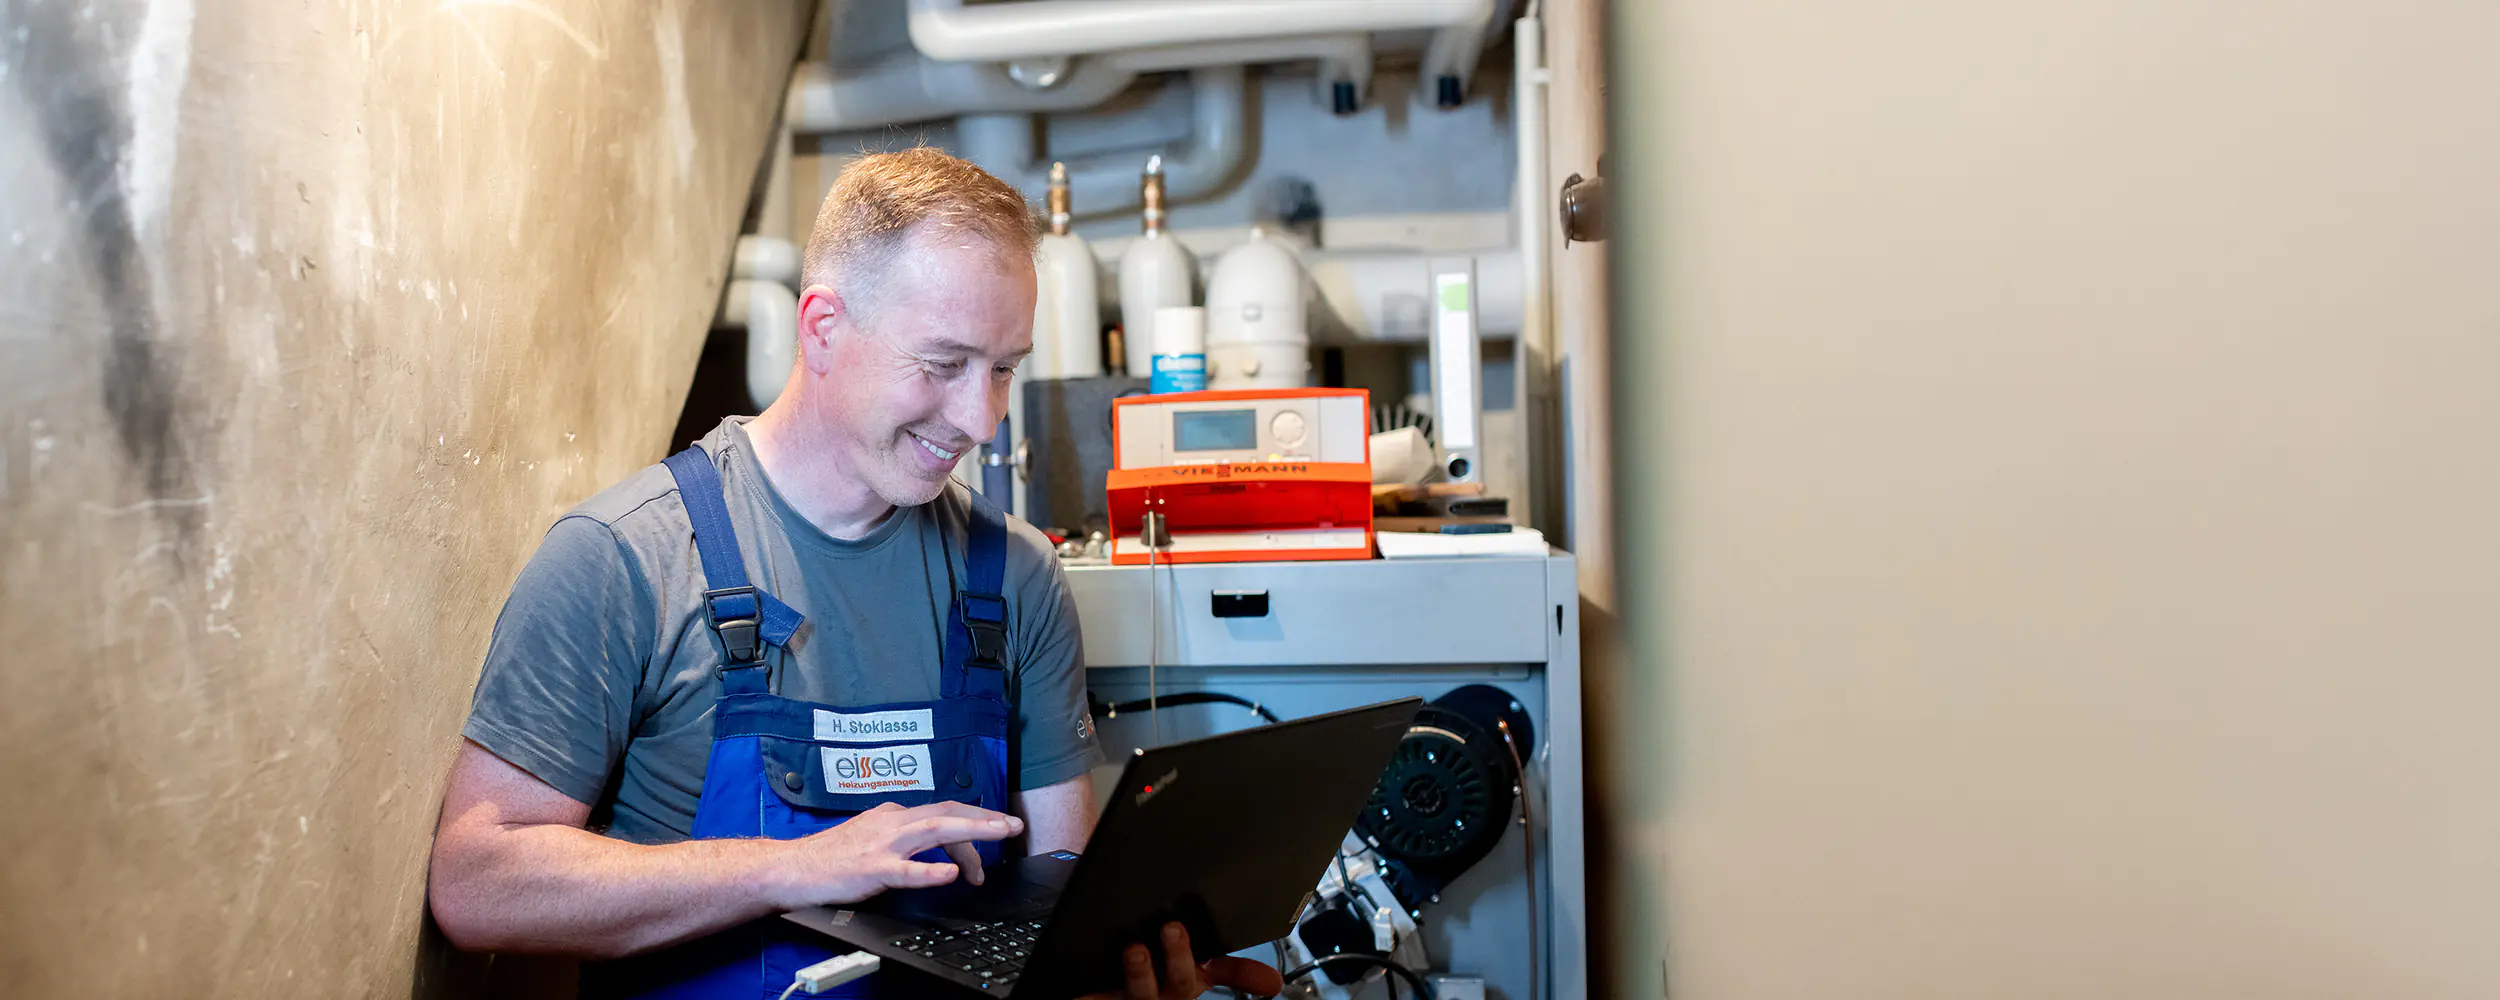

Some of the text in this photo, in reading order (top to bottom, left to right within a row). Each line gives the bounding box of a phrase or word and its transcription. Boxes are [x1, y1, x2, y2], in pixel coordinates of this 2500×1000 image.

[833, 719, 918, 734] H. Stoklassa
[835, 752, 918, 779] eissele
[838, 779, 920, 790] Heizungsanlagen
